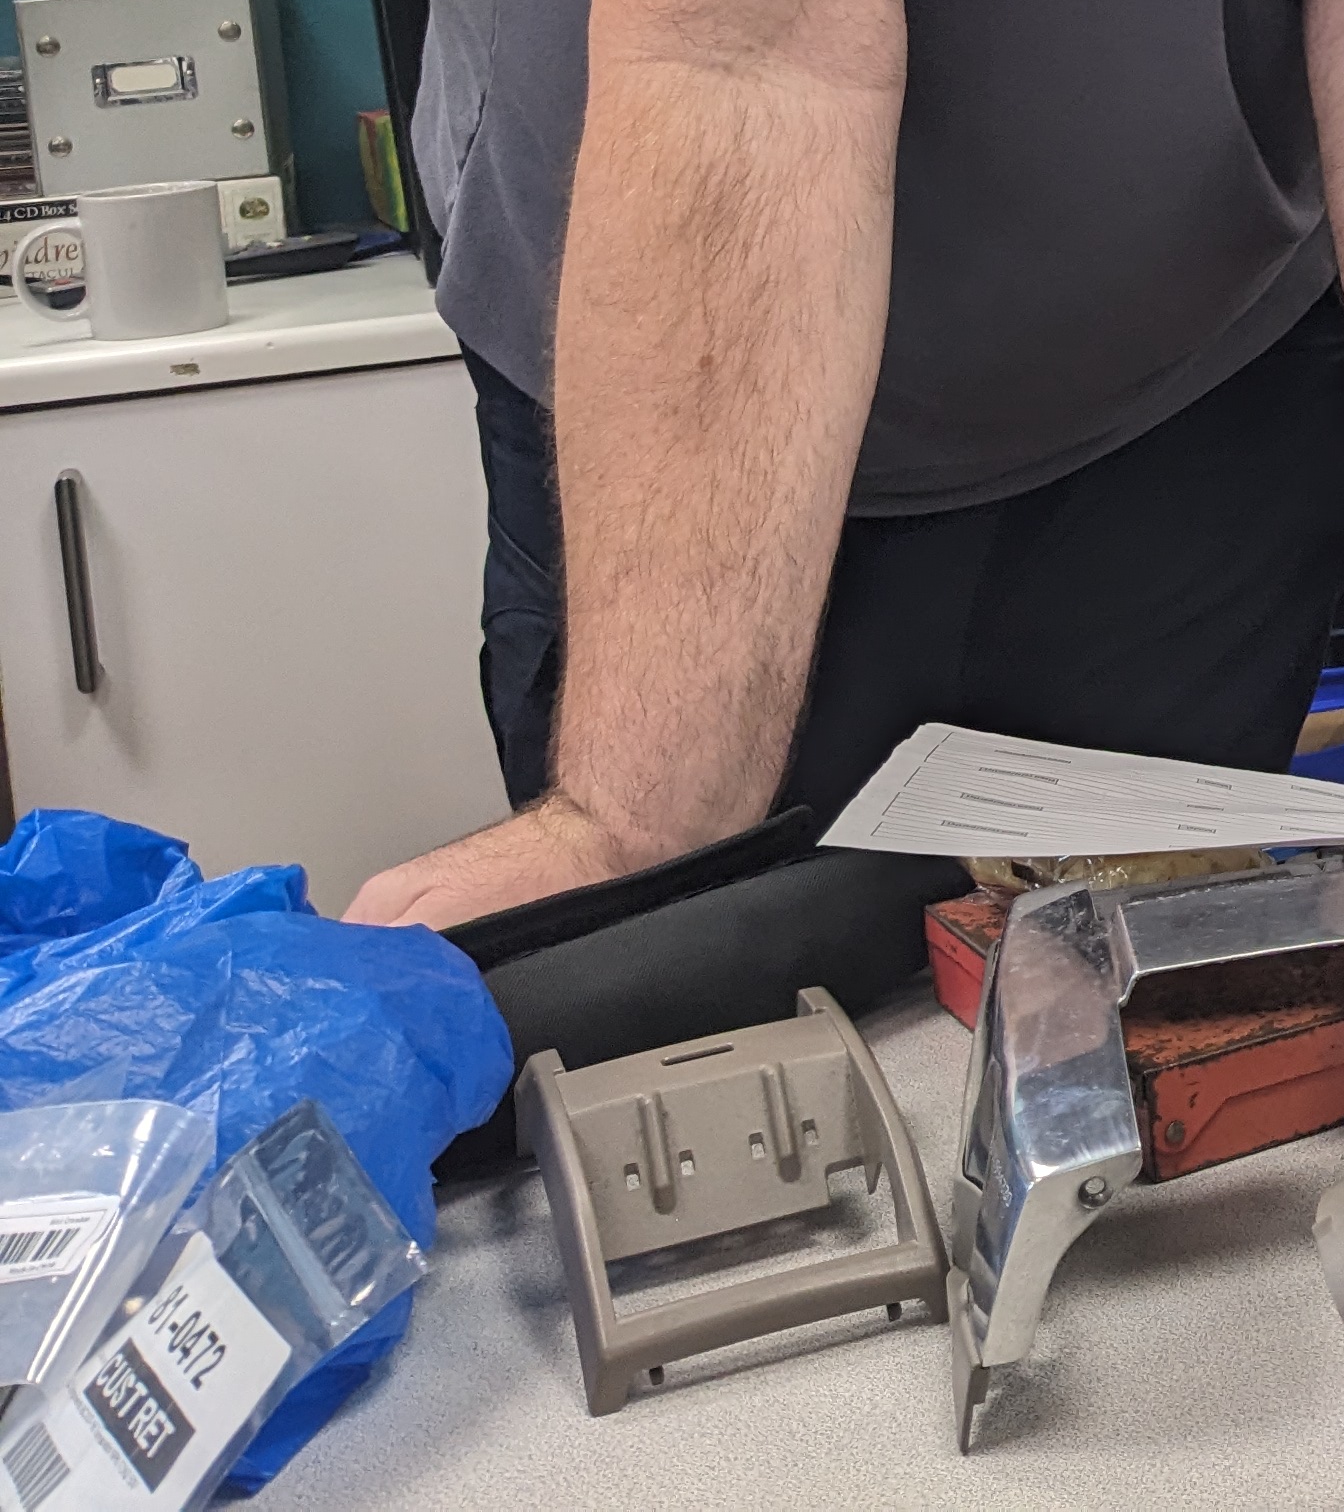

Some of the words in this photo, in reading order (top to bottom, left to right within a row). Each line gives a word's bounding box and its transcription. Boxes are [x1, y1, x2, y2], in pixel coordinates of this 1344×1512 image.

[14, 207, 39, 219] CD
[41, 205, 66, 217] Box
[148, 1285, 227, 1391] 81-0472
[96, 1352, 148, 1418] CUST
[128, 1396, 176, 1458] RET
